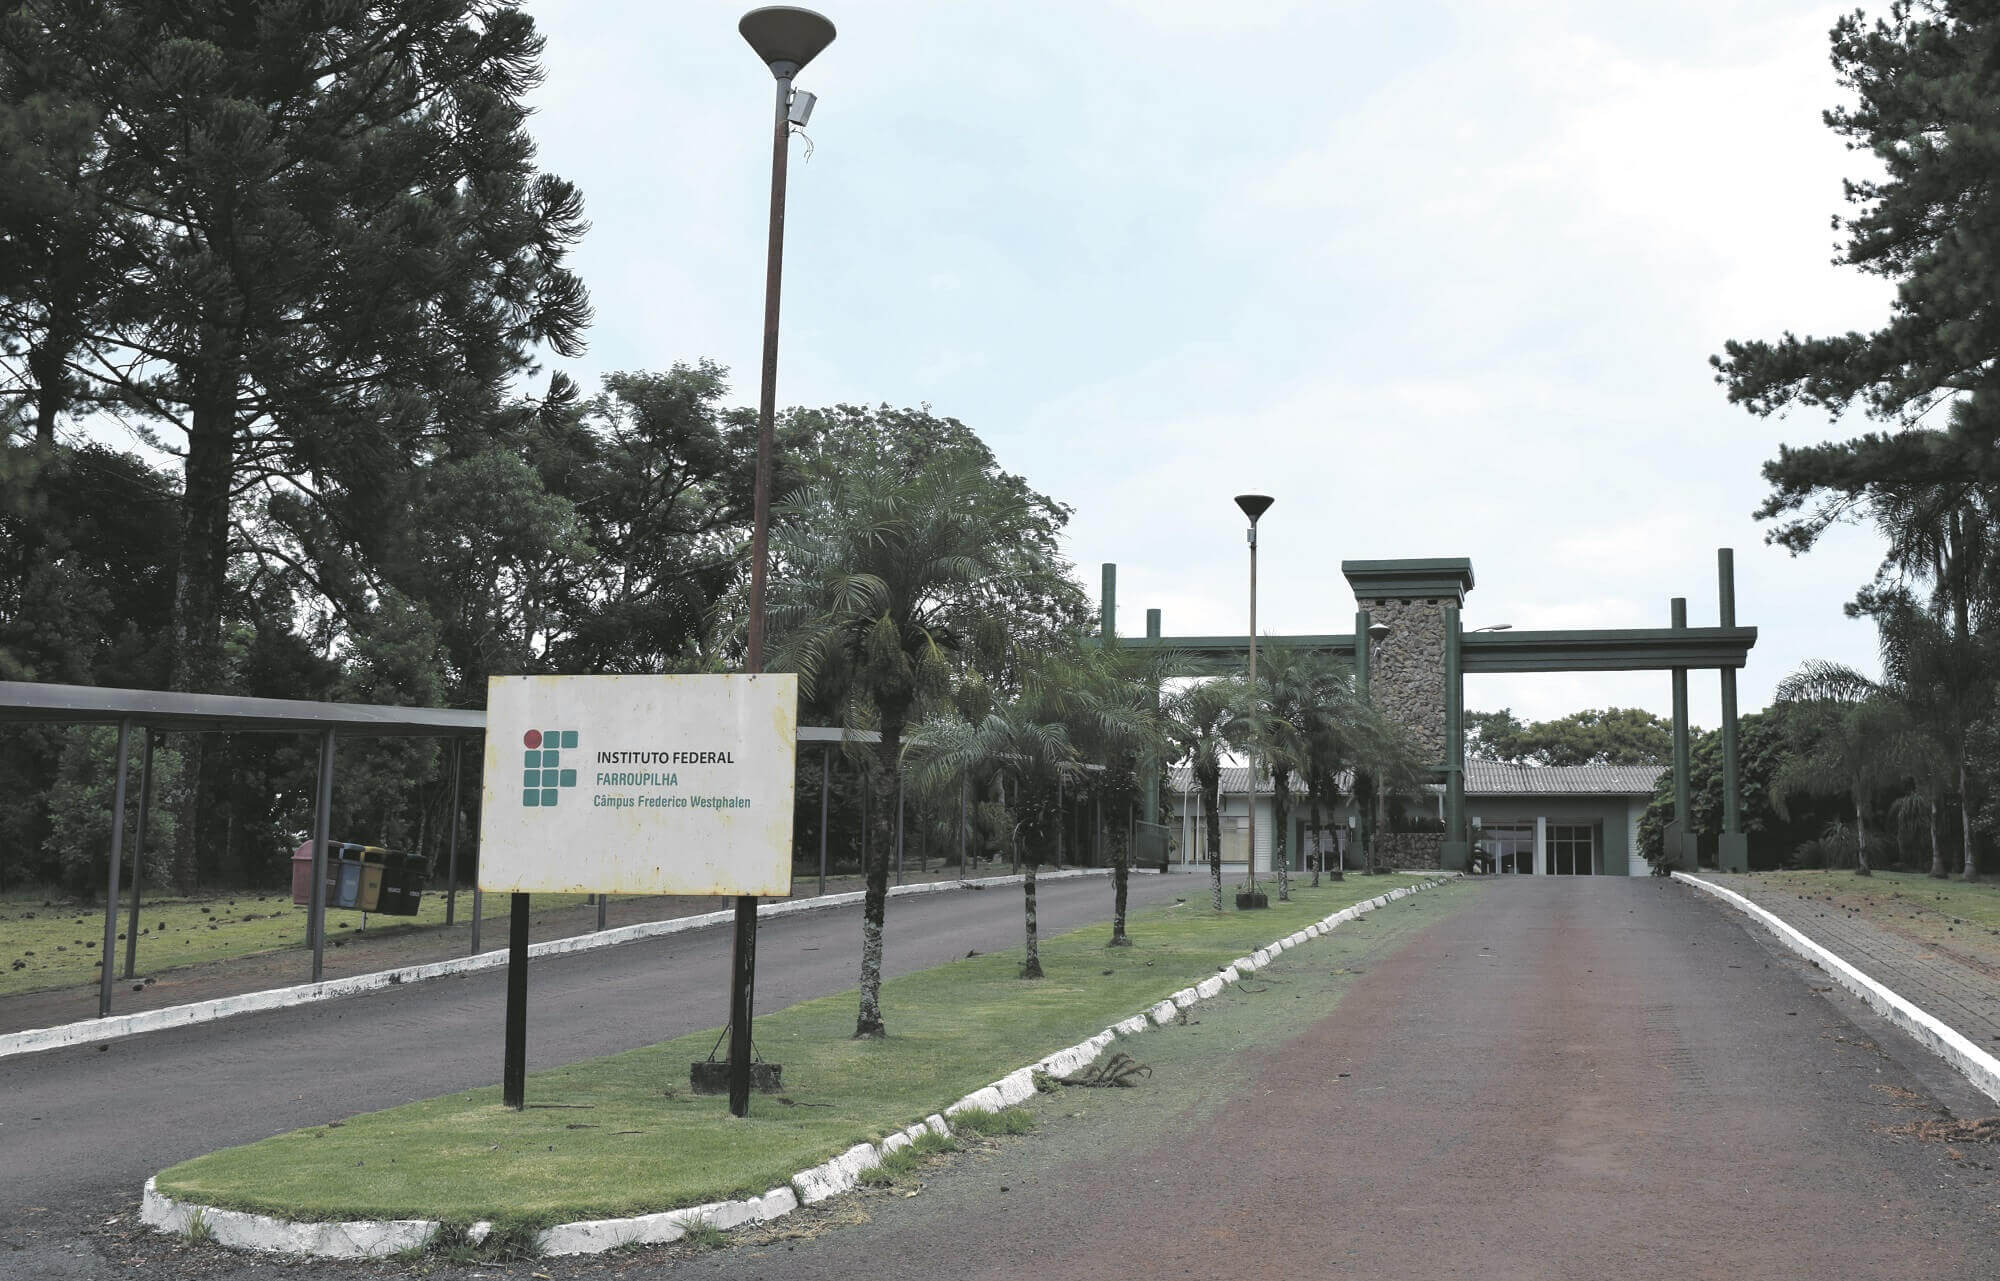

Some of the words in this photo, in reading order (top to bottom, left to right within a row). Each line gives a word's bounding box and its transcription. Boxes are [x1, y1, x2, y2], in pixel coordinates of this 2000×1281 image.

[597, 751, 669, 764] INSTITUTO
[672, 751, 735, 764] FEDERAL
[596, 773, 678, 786] FARROUPILHA
[593, 794, 635, 809] Câmpus
[637, 795, 687, 808] Frederico
[690, 796, 751, 811] Westphalen
